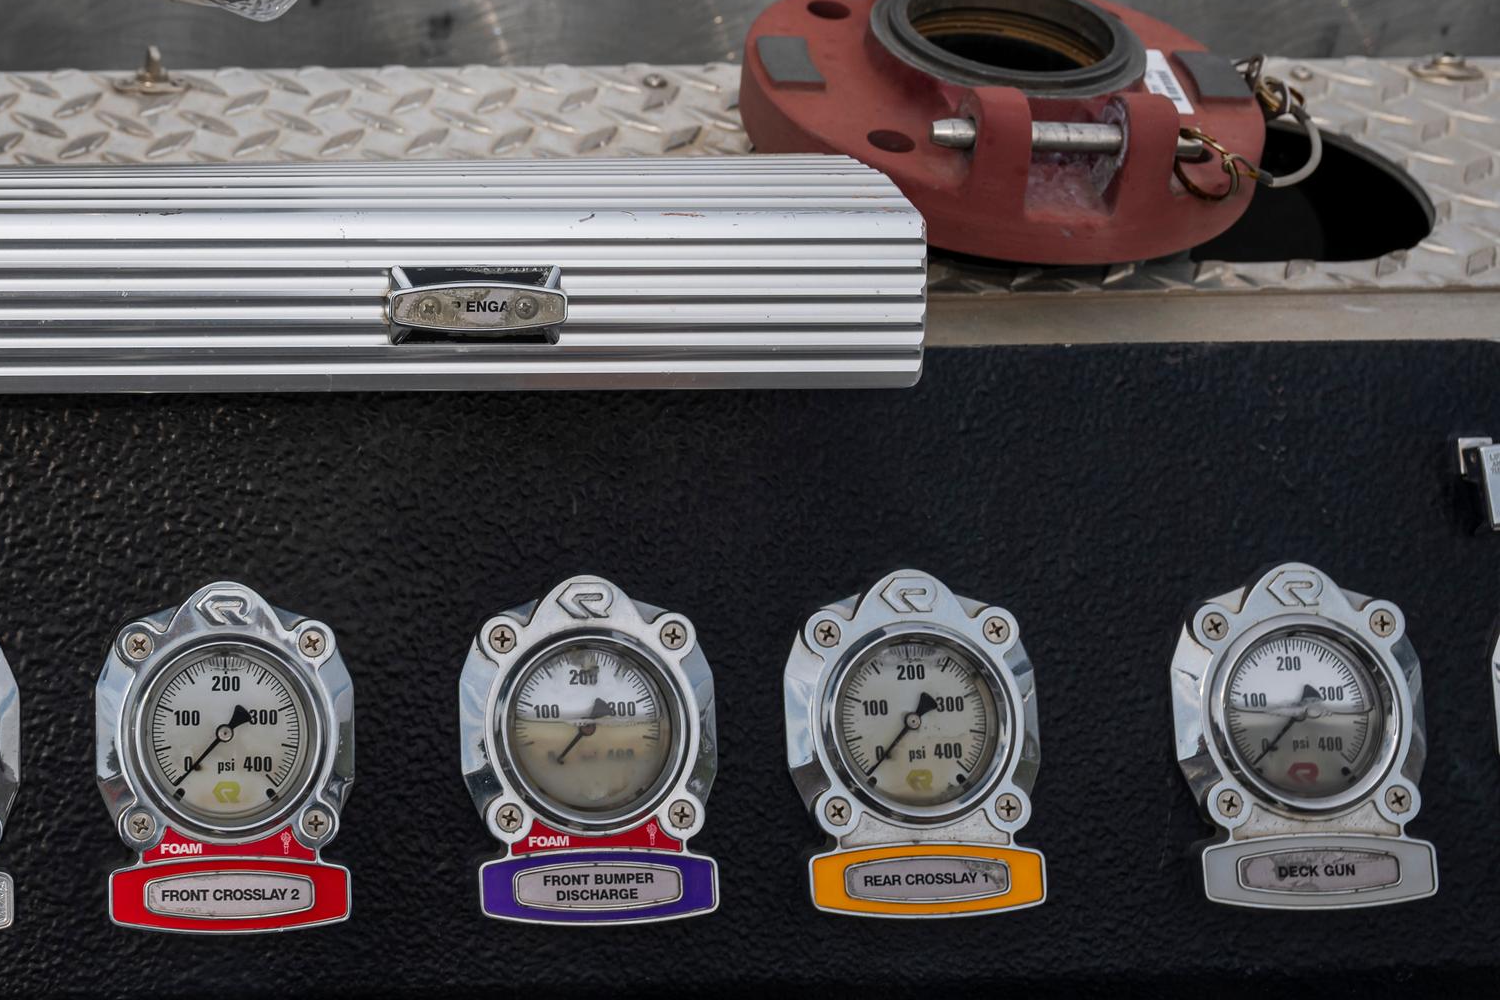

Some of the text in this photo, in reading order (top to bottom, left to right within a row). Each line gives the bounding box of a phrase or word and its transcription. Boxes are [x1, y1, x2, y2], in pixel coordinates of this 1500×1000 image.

[1276, 656, 1301, 672] 200
[896, 664, 925, 680] 200
[212, 676, 240, 692] 200
[1242, 693, 1267, 707] 100
[1320, 686, 1344, 701] 300
[534, 704, 560, 719] 100
[608, 702, 636, 716] 300
[862, 700, 888, 716] 100
[936, 696, 964, 713] 300
[174, 710, 200, 726] 100
[250, 709, 278, 726] 300
[1292, 737, 1310, 750] psi
[1318, 737, 1342, 752] 400
[908, 746, 926, 763] psi
[934, 743, 962, 760] 400
[217, 757, 235, 774] psi
[243, 756, 272, 772] 400
[160, 843, 202, 854] FOAM
[528, 836, 570, 847] FOAM
[1278, 863, 1356, 878] DECK GUN
[543, 872, 654, 886] FRONT BUMPER
[864, 872, 989, 886] REAR CROSSLAY 1
[162, 888, 300, 902] FRONT CROSSLAY 2
[556, 887, 638, 901] DISCHARGE
